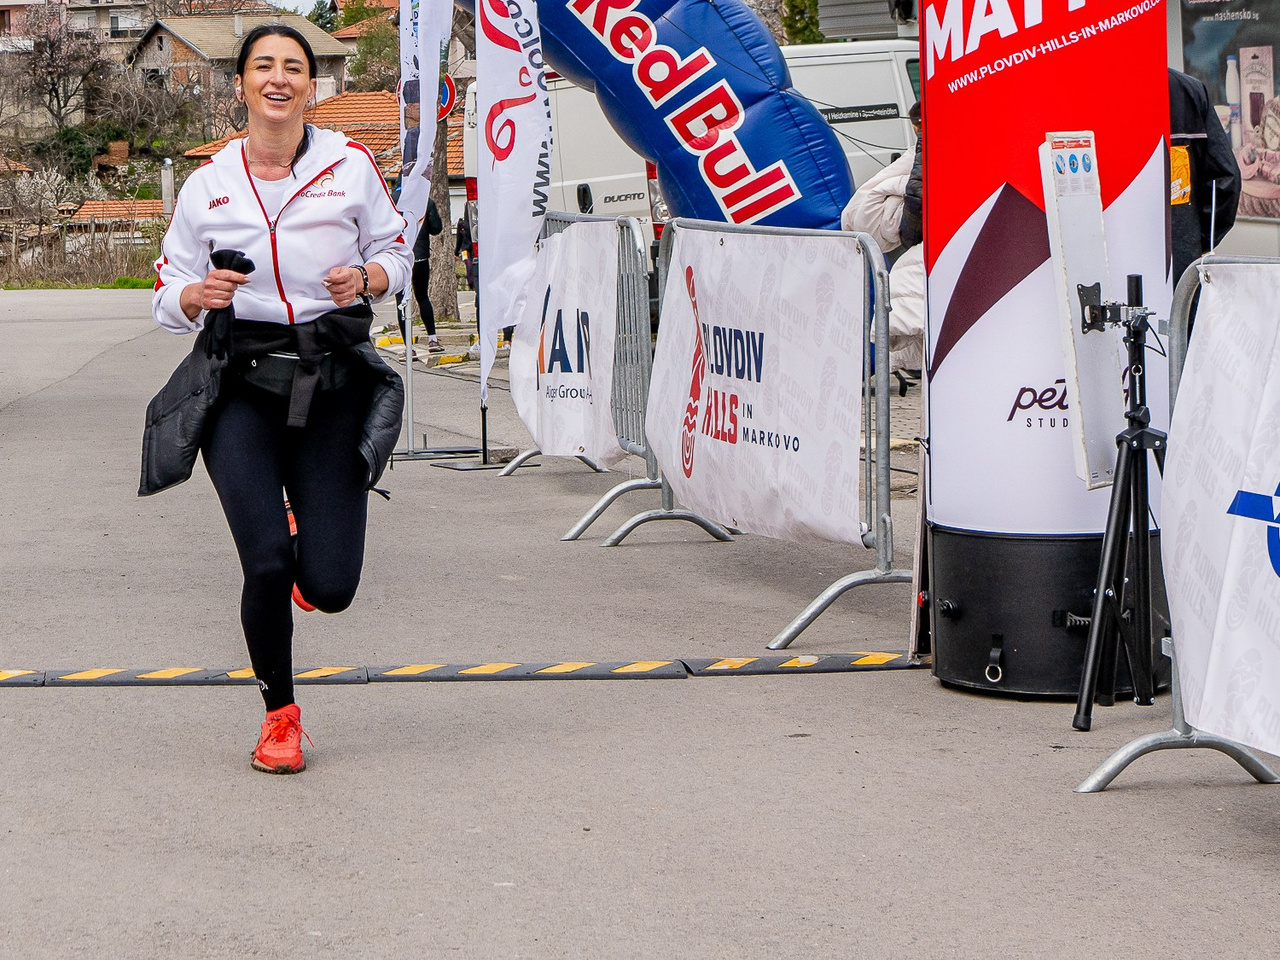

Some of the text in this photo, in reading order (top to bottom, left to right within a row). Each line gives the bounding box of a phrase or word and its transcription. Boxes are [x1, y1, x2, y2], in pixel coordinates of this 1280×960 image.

[666, 80, 800, 224] Bull
[327, 189, 346, 198] Bank
[604, 192, 645, 203] DUCATO
[208, 196, 230, 210] JAKO
[742, 403, 753, 419] IN
[1026, 417, 1069, 428] STUD
[742, 426, 800, 452] MARKOVO
